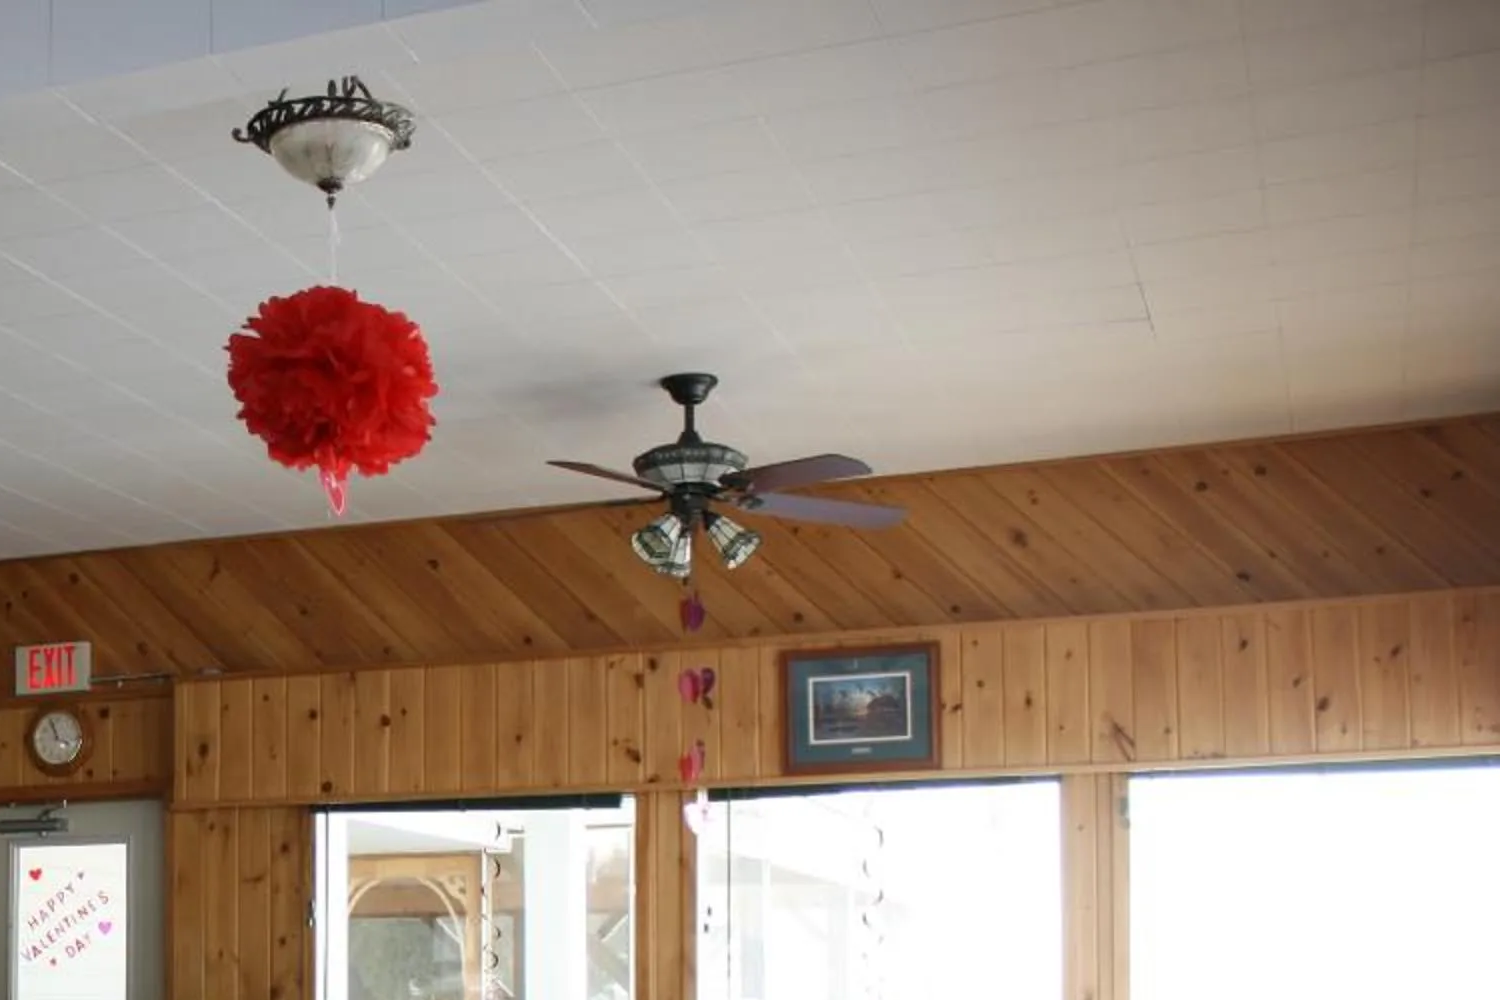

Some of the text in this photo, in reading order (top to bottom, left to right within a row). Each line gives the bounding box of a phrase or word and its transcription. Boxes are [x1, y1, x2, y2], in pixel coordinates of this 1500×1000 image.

[28, 644, 76, 689] EXIT
[27, 882, 75, 931] HAPPY
[65, 933, 92, 958] DAY
